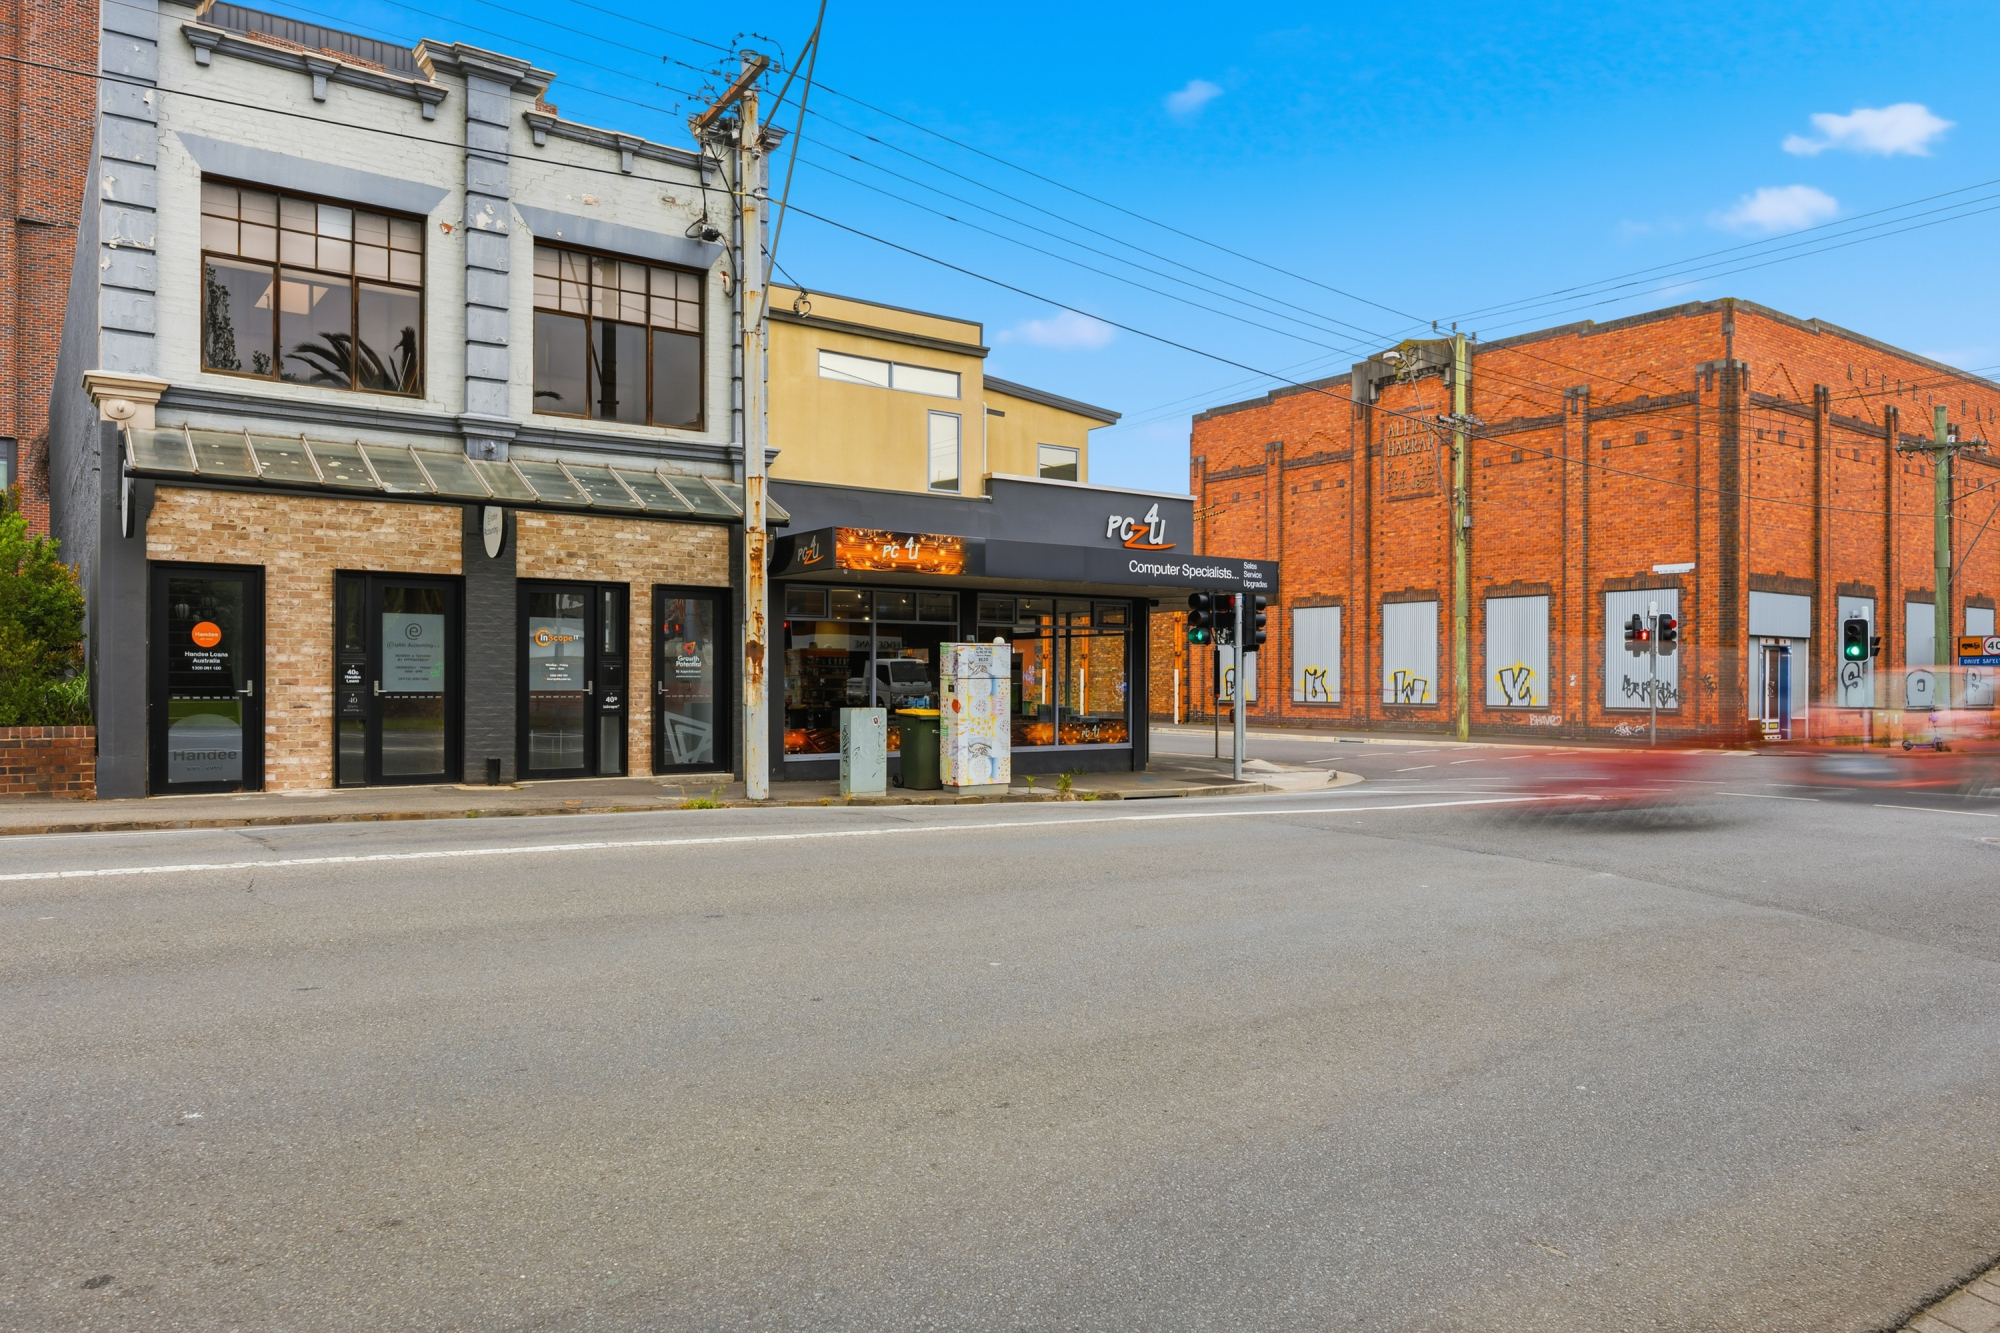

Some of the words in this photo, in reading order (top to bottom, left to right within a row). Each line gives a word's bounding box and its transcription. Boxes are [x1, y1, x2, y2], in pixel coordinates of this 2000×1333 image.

[1408, 456, 1434, 466] SON
[1129, 559, 1180, 577] Computer
[1182, 563, 1240, 580] Specialists...
[1243, 561, 1258, 570] Sales
[1243, 570, 1263, 579] Service
[1243, 579, 1268, 589] Upgrades
[173, 749, 237, 761] Handee
